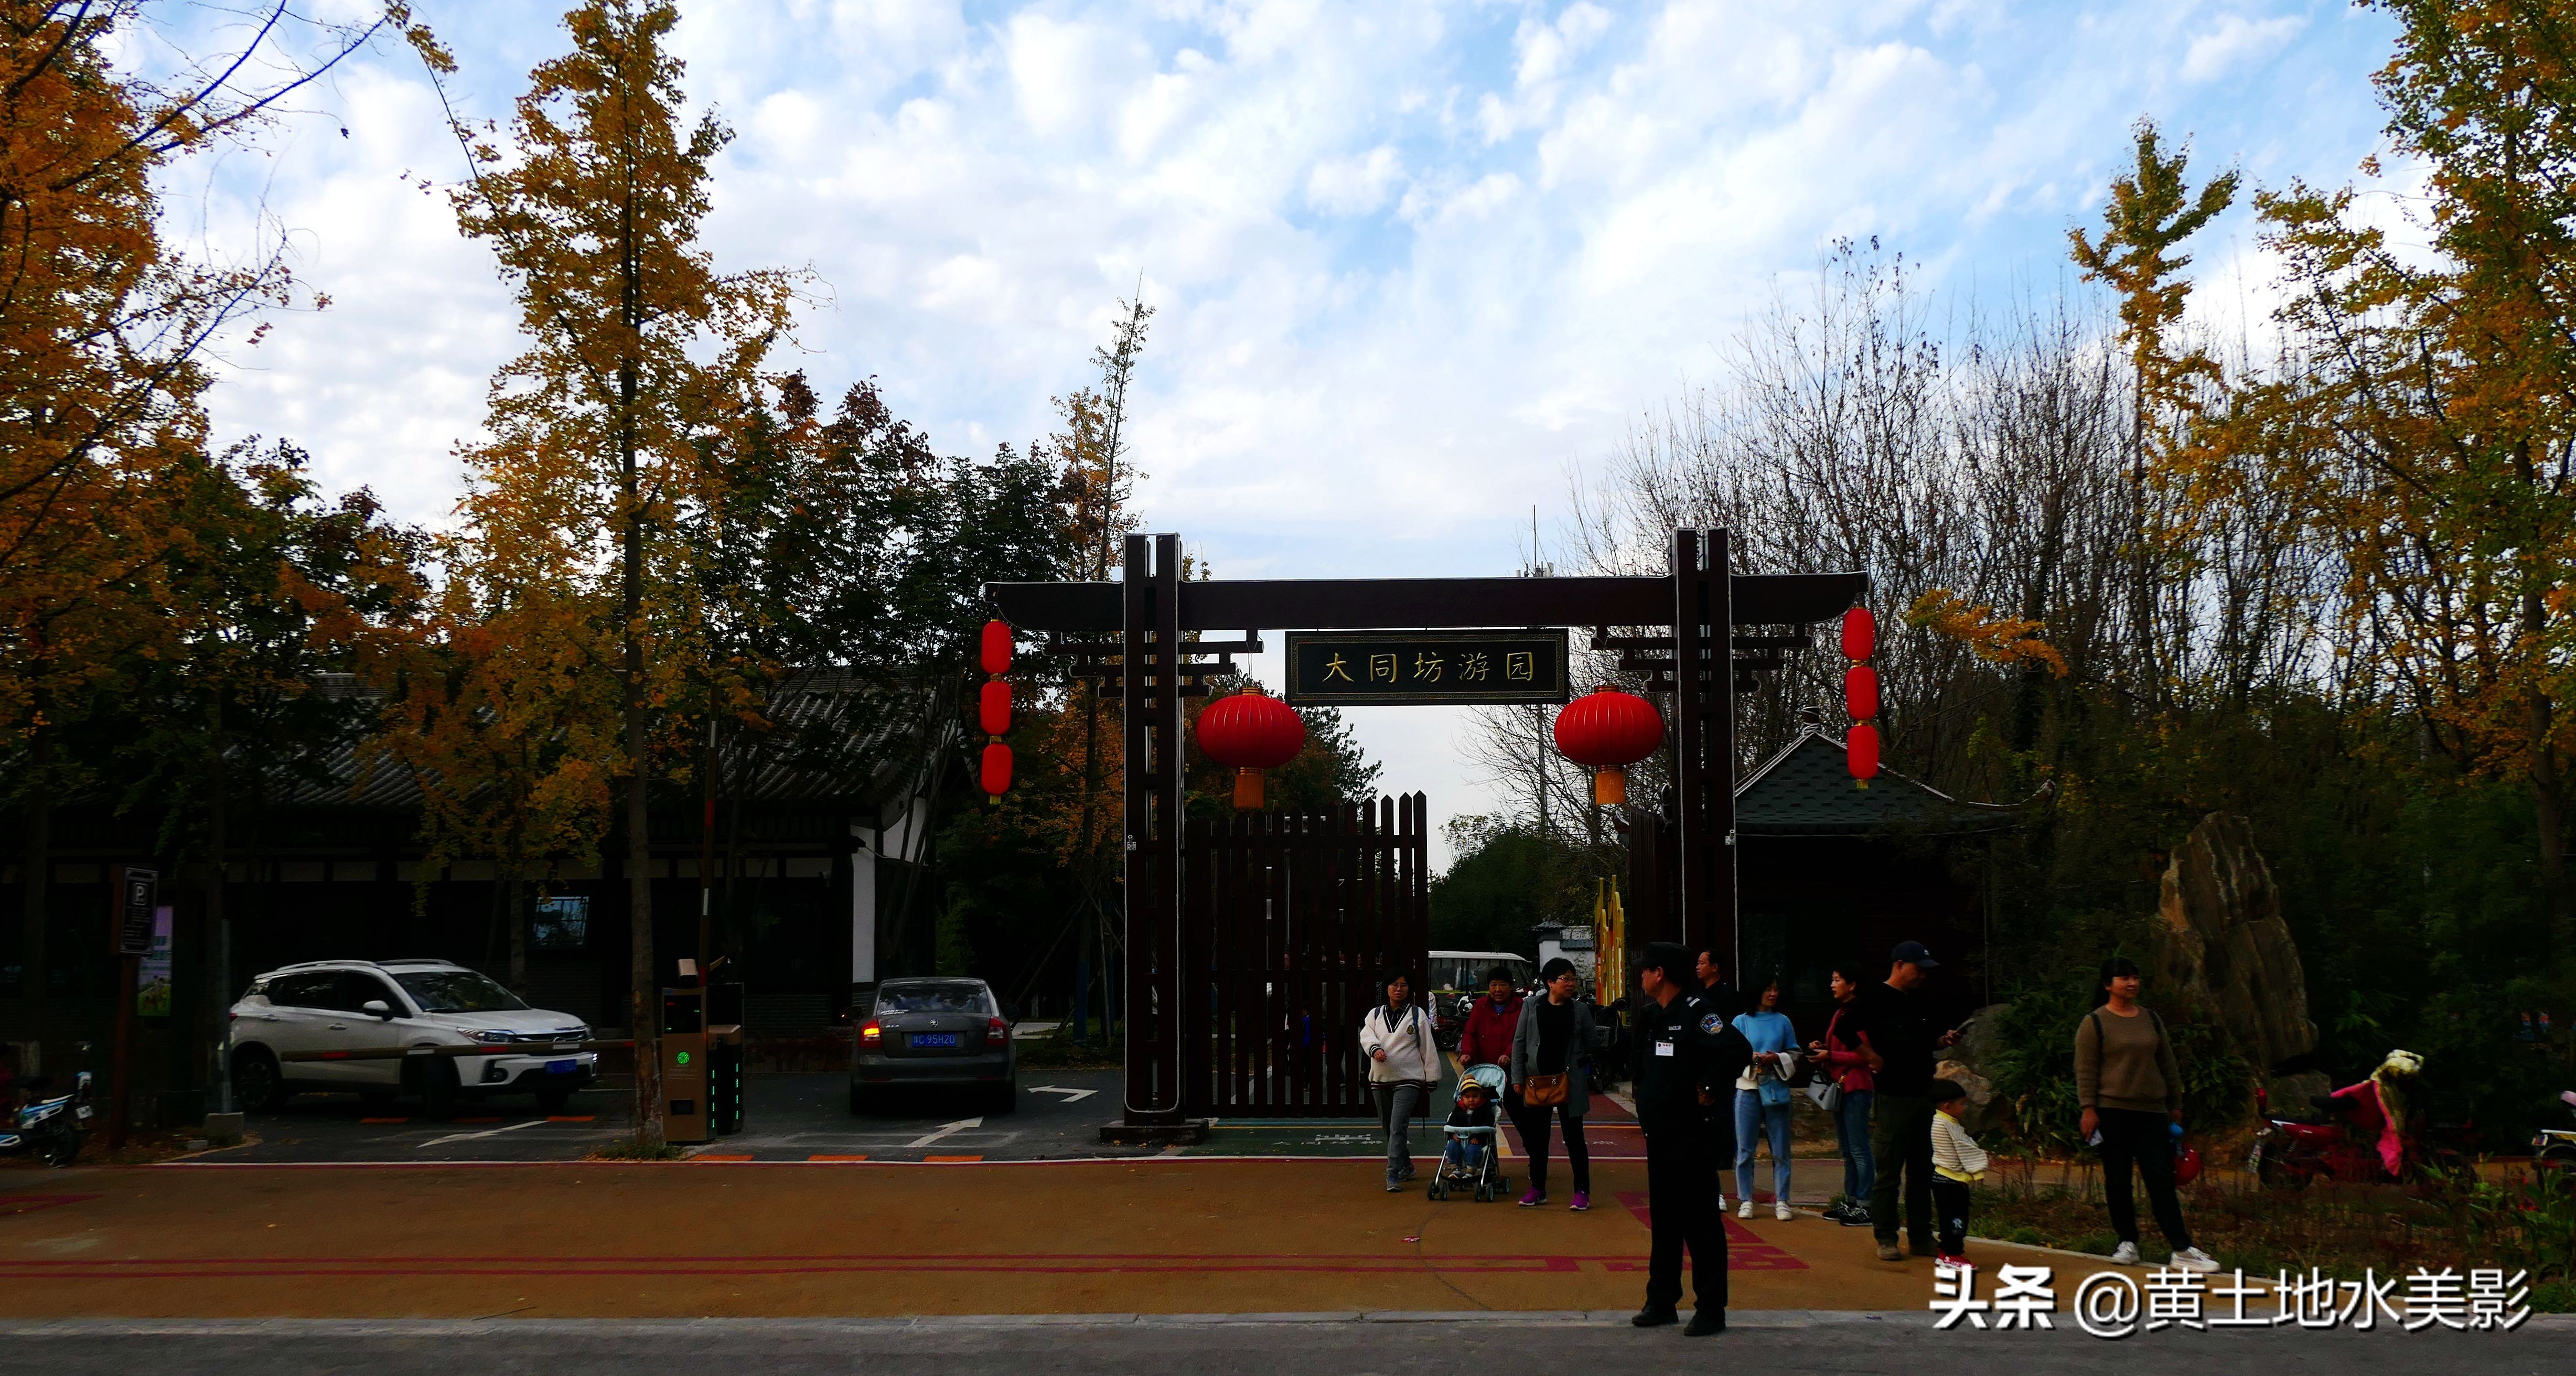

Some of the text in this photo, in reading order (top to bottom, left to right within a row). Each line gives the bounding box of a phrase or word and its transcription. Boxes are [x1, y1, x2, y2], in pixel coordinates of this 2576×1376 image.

[1322, 652, 1533, 683] 大同坊游园
